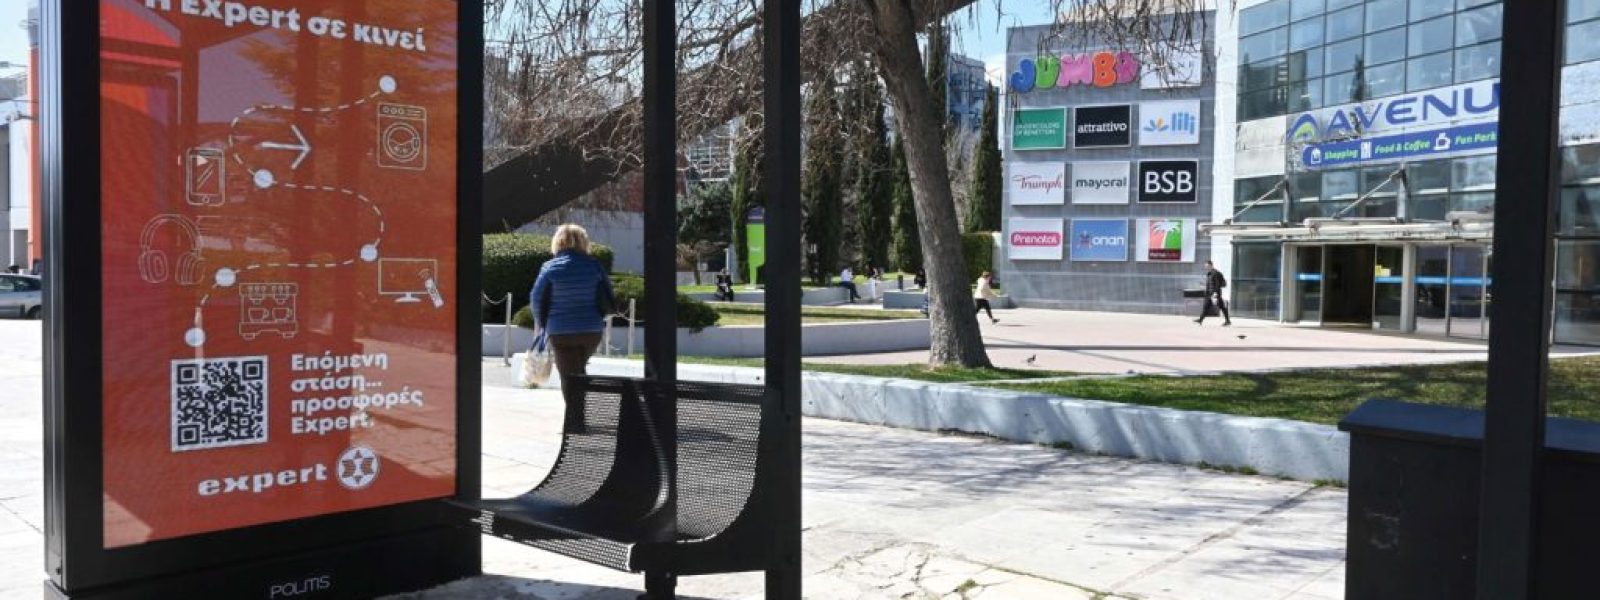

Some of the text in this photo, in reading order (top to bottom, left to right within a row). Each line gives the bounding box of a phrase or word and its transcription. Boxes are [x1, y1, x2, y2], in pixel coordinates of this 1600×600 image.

[181, 0, 300, 32] Expert
[307, 16, 347, 39] σε
[353, 23, 426, 51] κινεί
[1010, 52, 1140, 92] JUMBO
[1077, 121, 1128, 134] attrattivo
[1375, 144, 1395, 154] Food
[1404, 139, 1430, 151] Coffee
[1011, 173, 1062, 194] Triumph
[1075, 177, 1127, 189] mayoral
[1144, 171, 1193, 194] BSB
[291, 350, 388, 373] Επόμενη
[291, 386, 423, 416] προσφορές
[291, 412, 375, 434] Expert.
[198, 463, 328, 496] expert
